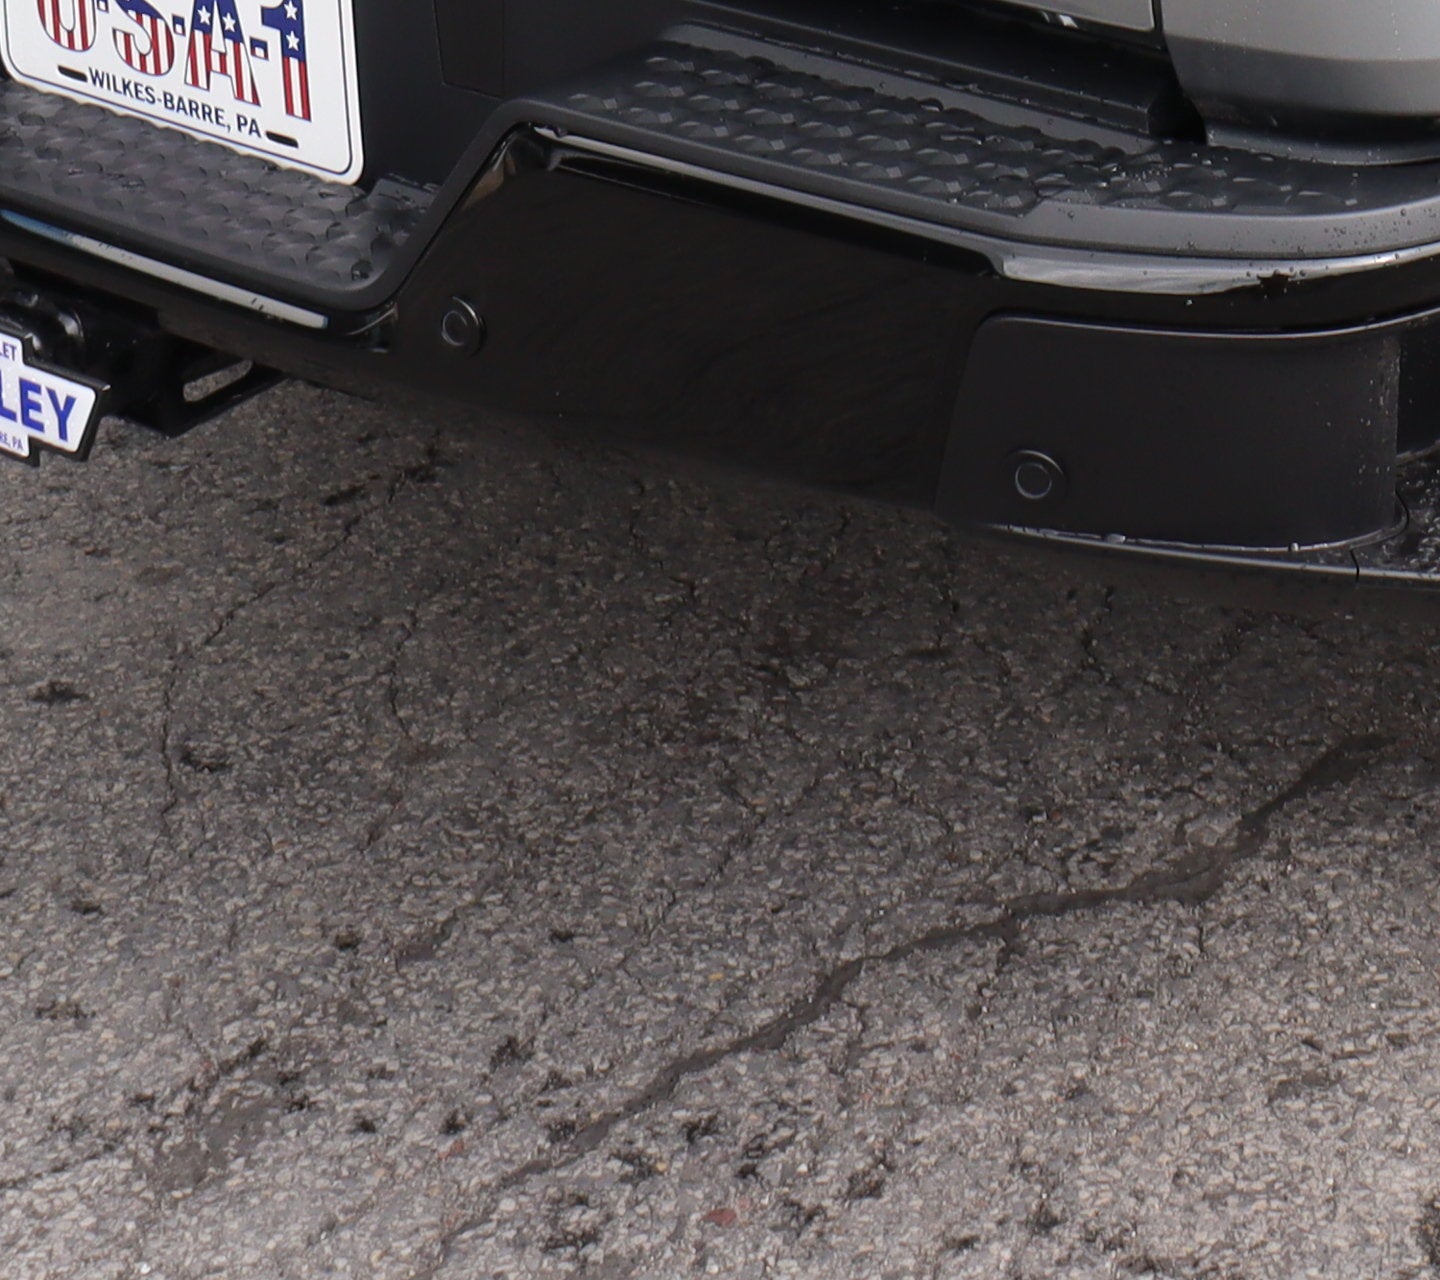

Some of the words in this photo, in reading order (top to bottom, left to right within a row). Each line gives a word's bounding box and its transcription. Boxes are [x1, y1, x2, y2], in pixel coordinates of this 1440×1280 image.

[87, 65, 232, 134] WILKES-BARRE,
[235, 112, 262, 139] PA
[12, 436, 24, 451] PA
